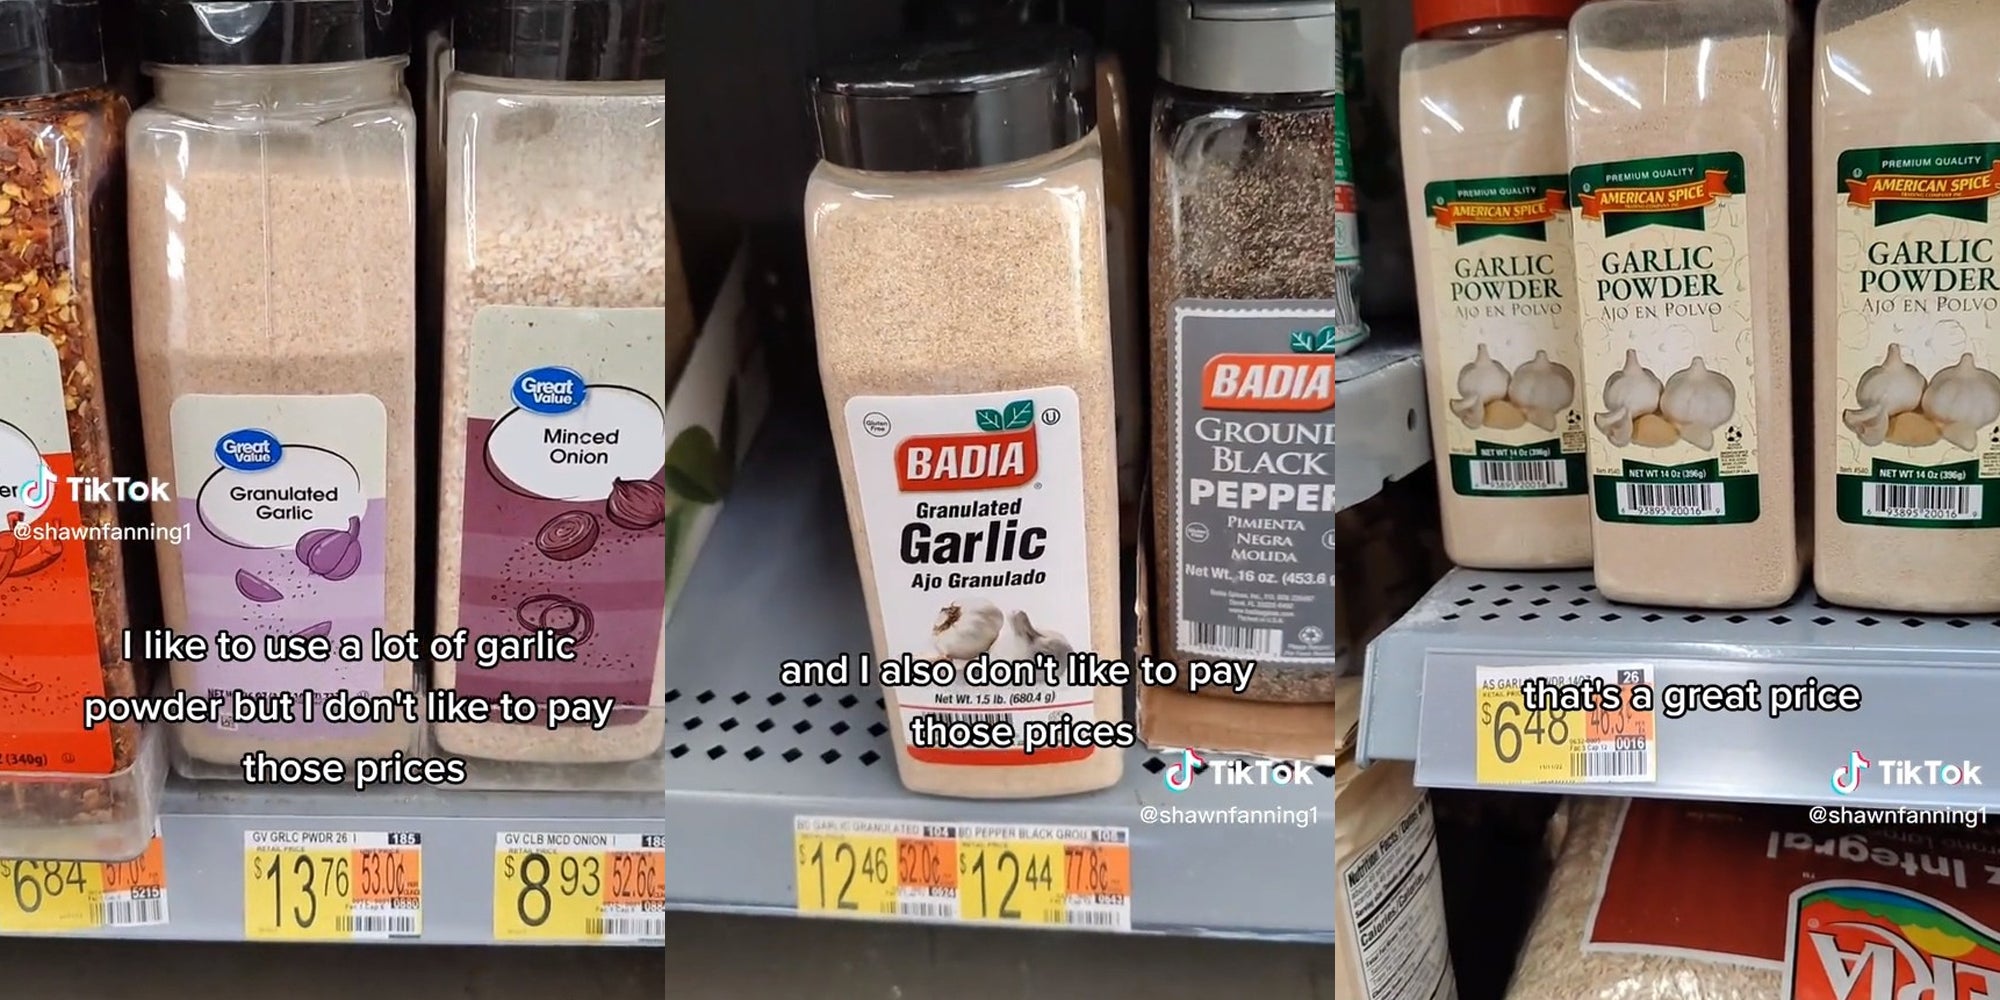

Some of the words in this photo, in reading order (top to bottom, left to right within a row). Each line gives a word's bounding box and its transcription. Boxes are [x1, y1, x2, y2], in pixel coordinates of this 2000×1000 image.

[1881, 158, 1932, 169] PREMIUM
[1935, 155, 1982, 166] QUALITY
[1605, 171, 1650, 183] PREMIUM
[1652, 167, 1694, 179] QUALITY
[1872, 178, 1948, 192] AMERICAN
[1950, 175, 1991, 191] SPICE
[1457, 188, 1497, 198] PREMIUM
[1499, 186, 1537, 196] QUALITY
[1600, 191, 1665, 206] AMERICAN
[1667, 184, 1705, 203] SPICE
[1452, 204, 1511, 218] AMERICAN
[1512, 202, 1546, 217] SPICE
[1868, 238, 1993, 266] GARLIC
[1454, 254, 1555, 279] GARLIC
[1601, 246, 1714, 275] GARLIC
[1596, 274, 1724, 302] POWDER
[1859, 267, 2000, 293] POWDER
[1450, 278, 1563, 302] POWDER
[521, 377, 573, 395] Great
[1211, 363, 1333, 400] BADIA
[533, 393, 573, 405] Value
[544, 428, 620, 445] Minced
[222, 439, 271, 454] Great
[235, 452, 272, 463] Value
[550, 448, 608, 464] Onion
[906, 441, 1025, 481] BADIA
[1211, 445, 1329, 475] BLACK
[1629, 469, 1644, 478] NET
[1646, 469, 1659, 478] WT
[1660, 469, 1670, 478] 14
[1879, 469, 1897, 478] NET
[1899, 469, 1914, 478] WT
[1916, 470, 1926, 479] 14
[230, 486, 338, 503] Granulated
[256, 505, 313, 520] Garlic
[916, 498, 1022, 519] Granulated
[1227, 515, 1306, 531] PIMIENTA
[900, 519, 1047, 565] Garlic
[1236, 532, 1294, 547] NEGRA
[1230, 548, 1298, 563] MOLIDA
[911, 573, 943, 591] Ajo
[948, 569, 1046, 589] Granulado
[1185, 563, 1208, 578] Net
[1211, 566, 1233, 580] Wt.
[1238, 570, 1255, 582] 16
[1257, 573, 1278, 584] oz.
[1281, 572, 1326, 587] (453.6
[1483, 679, 1495, 690] AS
[1623, 671, 1639, 683] 26
[935, 693, 954, 704] Net
[956, 693, 974, 704] Wt.
[976, 693, 992, 704] 1.5
[993, 693, 1007, 704] lb.
[1009, 692, 1041, 705] (680.4
[1044, 691, 1056, 704] g)
[1616, 736, 1644, 750] 0016
[6, 754, 48, 766] (340g)
[852, 823, 920, 834] GRANULATED
[974, 828, 1016, 838] PEPPER
[1019, 829, 1053, 839] BLACK
[1056, 830, 1087, 840] GROU
[253, 832, 268, 843] GV
[270, 832, 298, 843] GRLC
[302, 832, 334, 843] PWDR
[336, 832, 348, 843] 26
[392, 833, 416, 845] 185
[505, 833, 521, 844] GV
[523, 834, 545, 845] CLB
[547, 834, 571, 845] MCD
[573, 835, 607, 846] ONION
[1766, 830, 1967, 889] Integral
[132, 884, 161, 899] 5215
